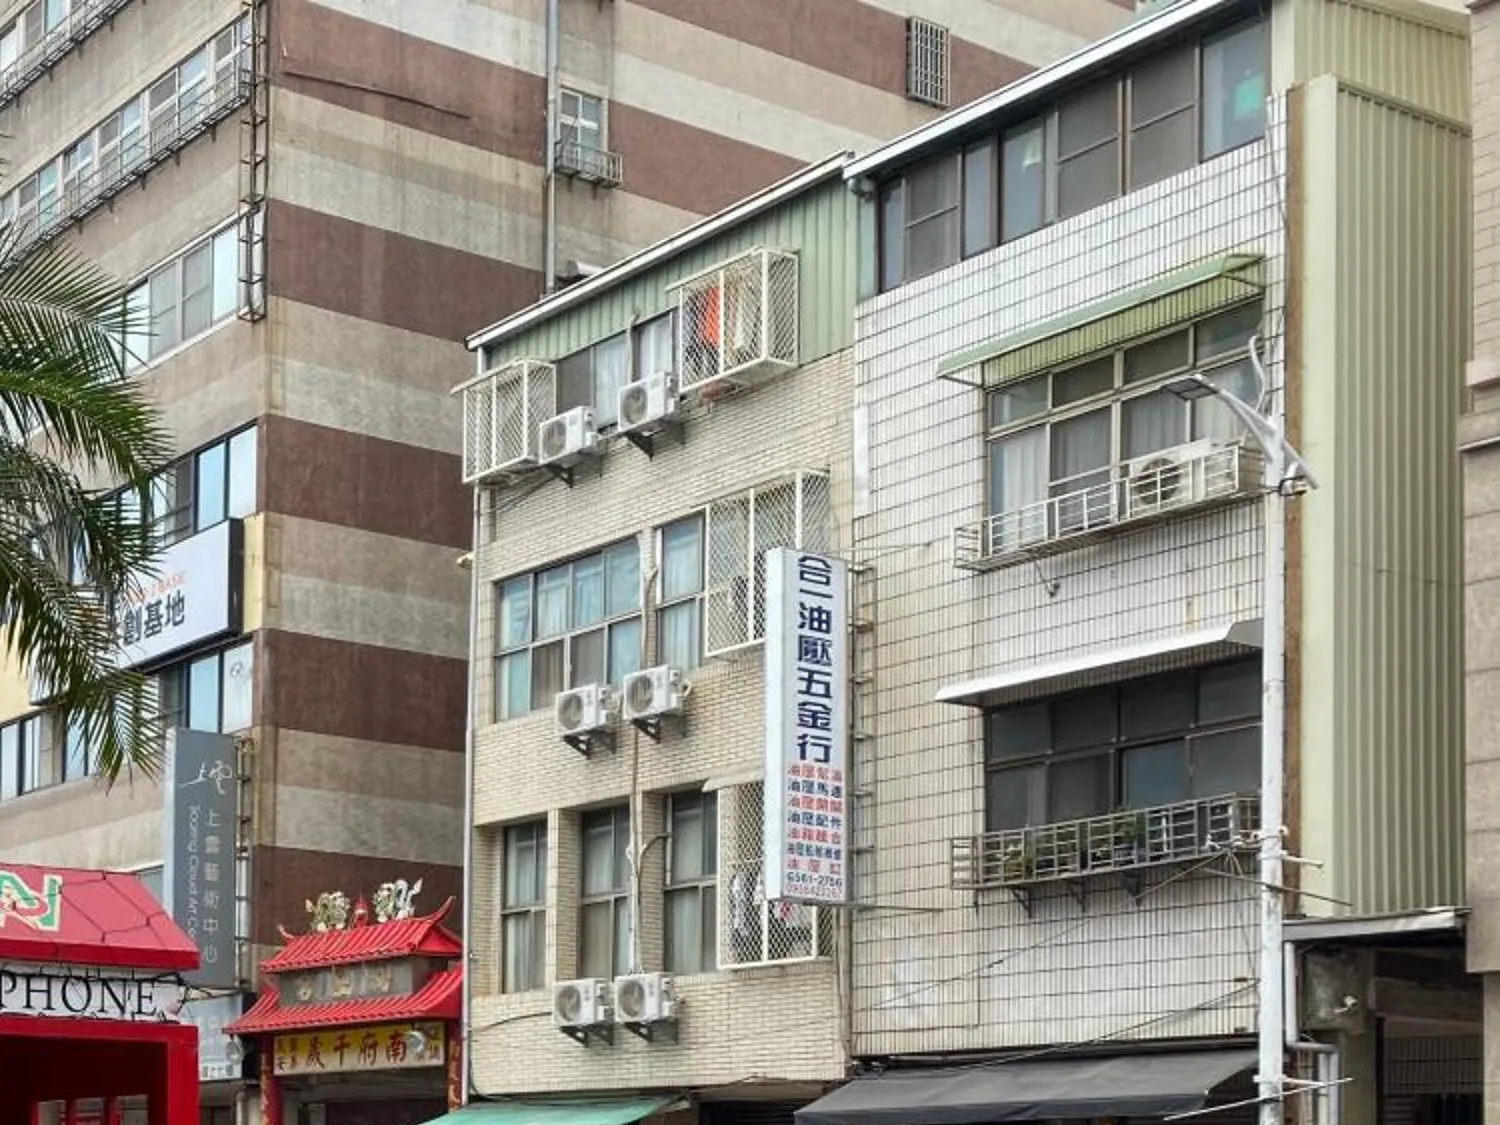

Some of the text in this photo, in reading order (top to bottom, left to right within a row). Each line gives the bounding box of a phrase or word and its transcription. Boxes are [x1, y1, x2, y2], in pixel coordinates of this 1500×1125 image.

[113, 589, 186, 648] 創基地
[797, 555, 833, 763] 合一油壓五金行
